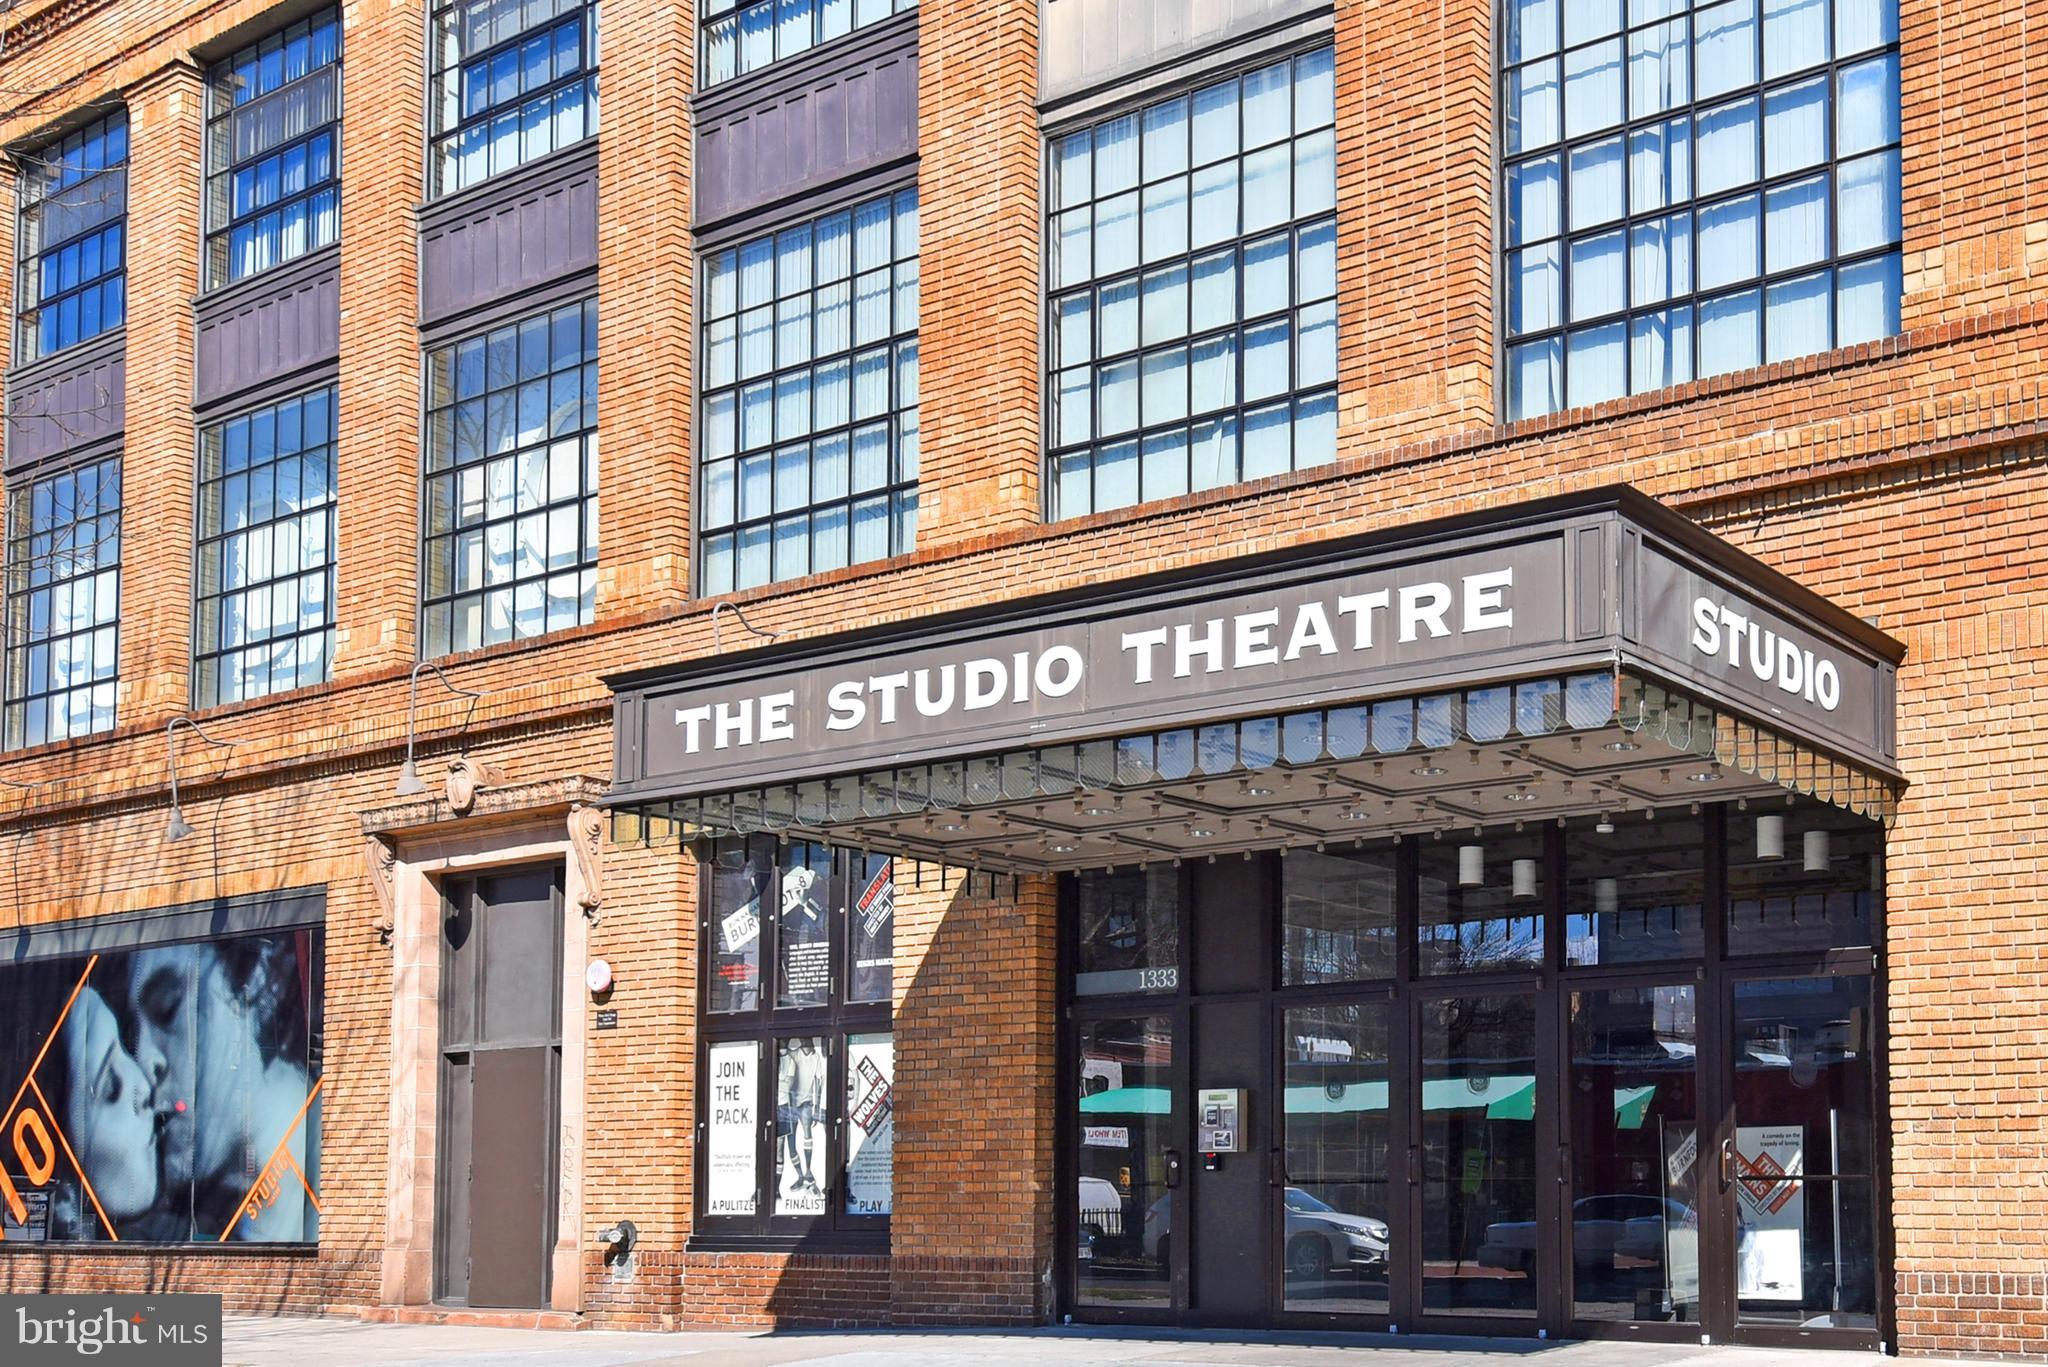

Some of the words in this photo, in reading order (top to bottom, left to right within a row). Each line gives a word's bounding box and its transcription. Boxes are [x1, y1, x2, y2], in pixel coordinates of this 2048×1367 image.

[675, 690, 794, 754] THE
[826, 644, 1084, 731] STUDIO
[1121, 566, 1513, 684] THEATRE
[1692, 597, 1840, 711] STUDIO
[1139, 968, 1177, 989] 1333
[716, 1061, 745, 1078] JOIN
[860, 1058, 880, 1086] THE
[716, 1085, 740, 1101] THE
[853, 1079, 889, 1125] WOLVES
[716, 1108, 753, 1125] PACK.
[246, 1151, 290, 1221] STUDIO
[712, 1200, 717, 1211] A
[785, 1198, 825, 1210] FINALIST
[859, 1200, 883, 1212] PLAY
